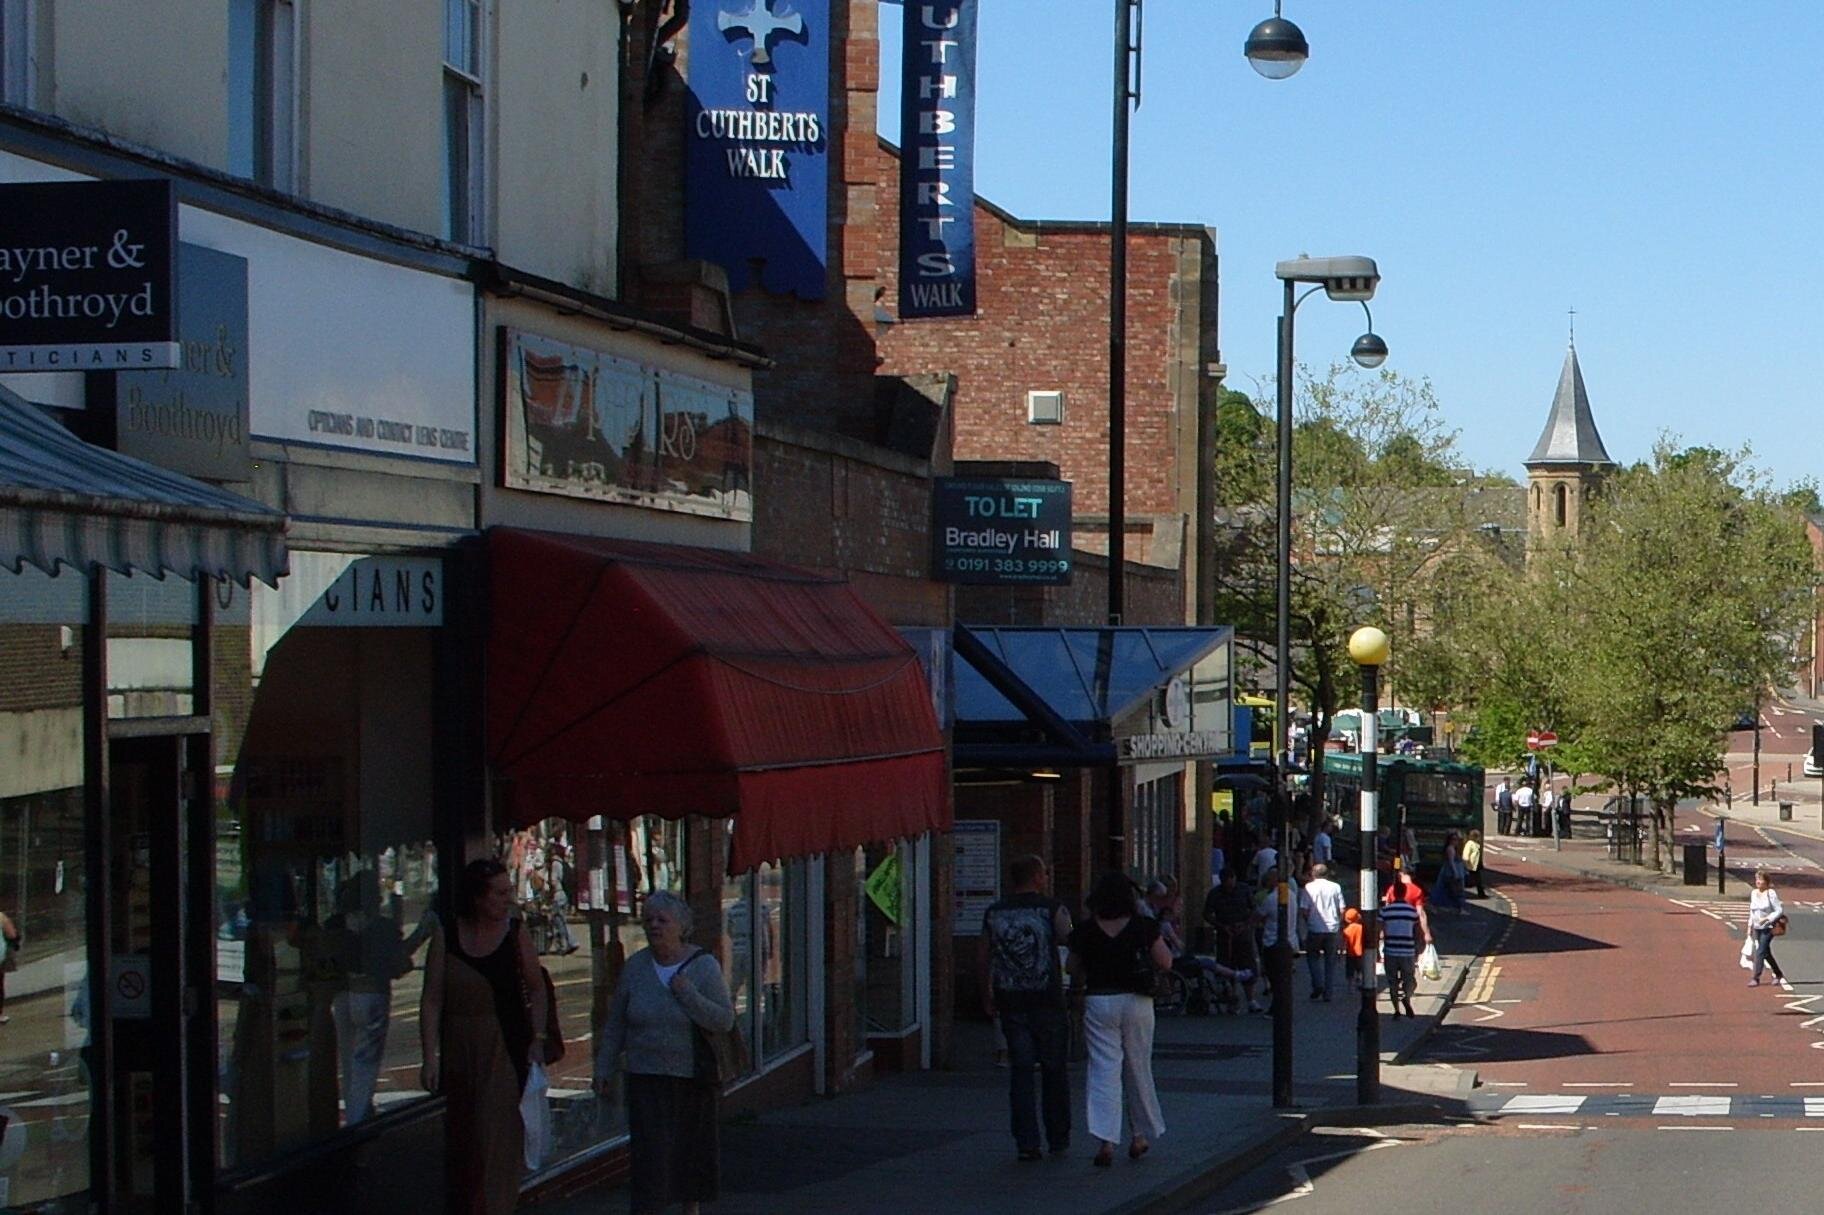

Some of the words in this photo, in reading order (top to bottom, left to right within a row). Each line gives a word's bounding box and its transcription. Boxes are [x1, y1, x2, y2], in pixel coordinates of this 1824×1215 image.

[747, 73, 771, 103] ST
[697, 111, 820, 144] CUTHBERTS
[726, 148, 786, 179] WALK
[107, 229, 145, 269] &
[0, 283, 153, 327] othroyd
[911, 283, 962, 308] WALK
[964, 496, 995, 517] TO
[1000, 497, 1042, 518] LET
[945, 527, 1018, 554] Bradley
[1023, 529, 1060, 549] Hall
[957, 558, 989, 571] 0191
[994, 559, 1024, 572] 383
[1028, 560, 1068, 573] 9999
[1130, 731, 1181, 758] SHOPPING
